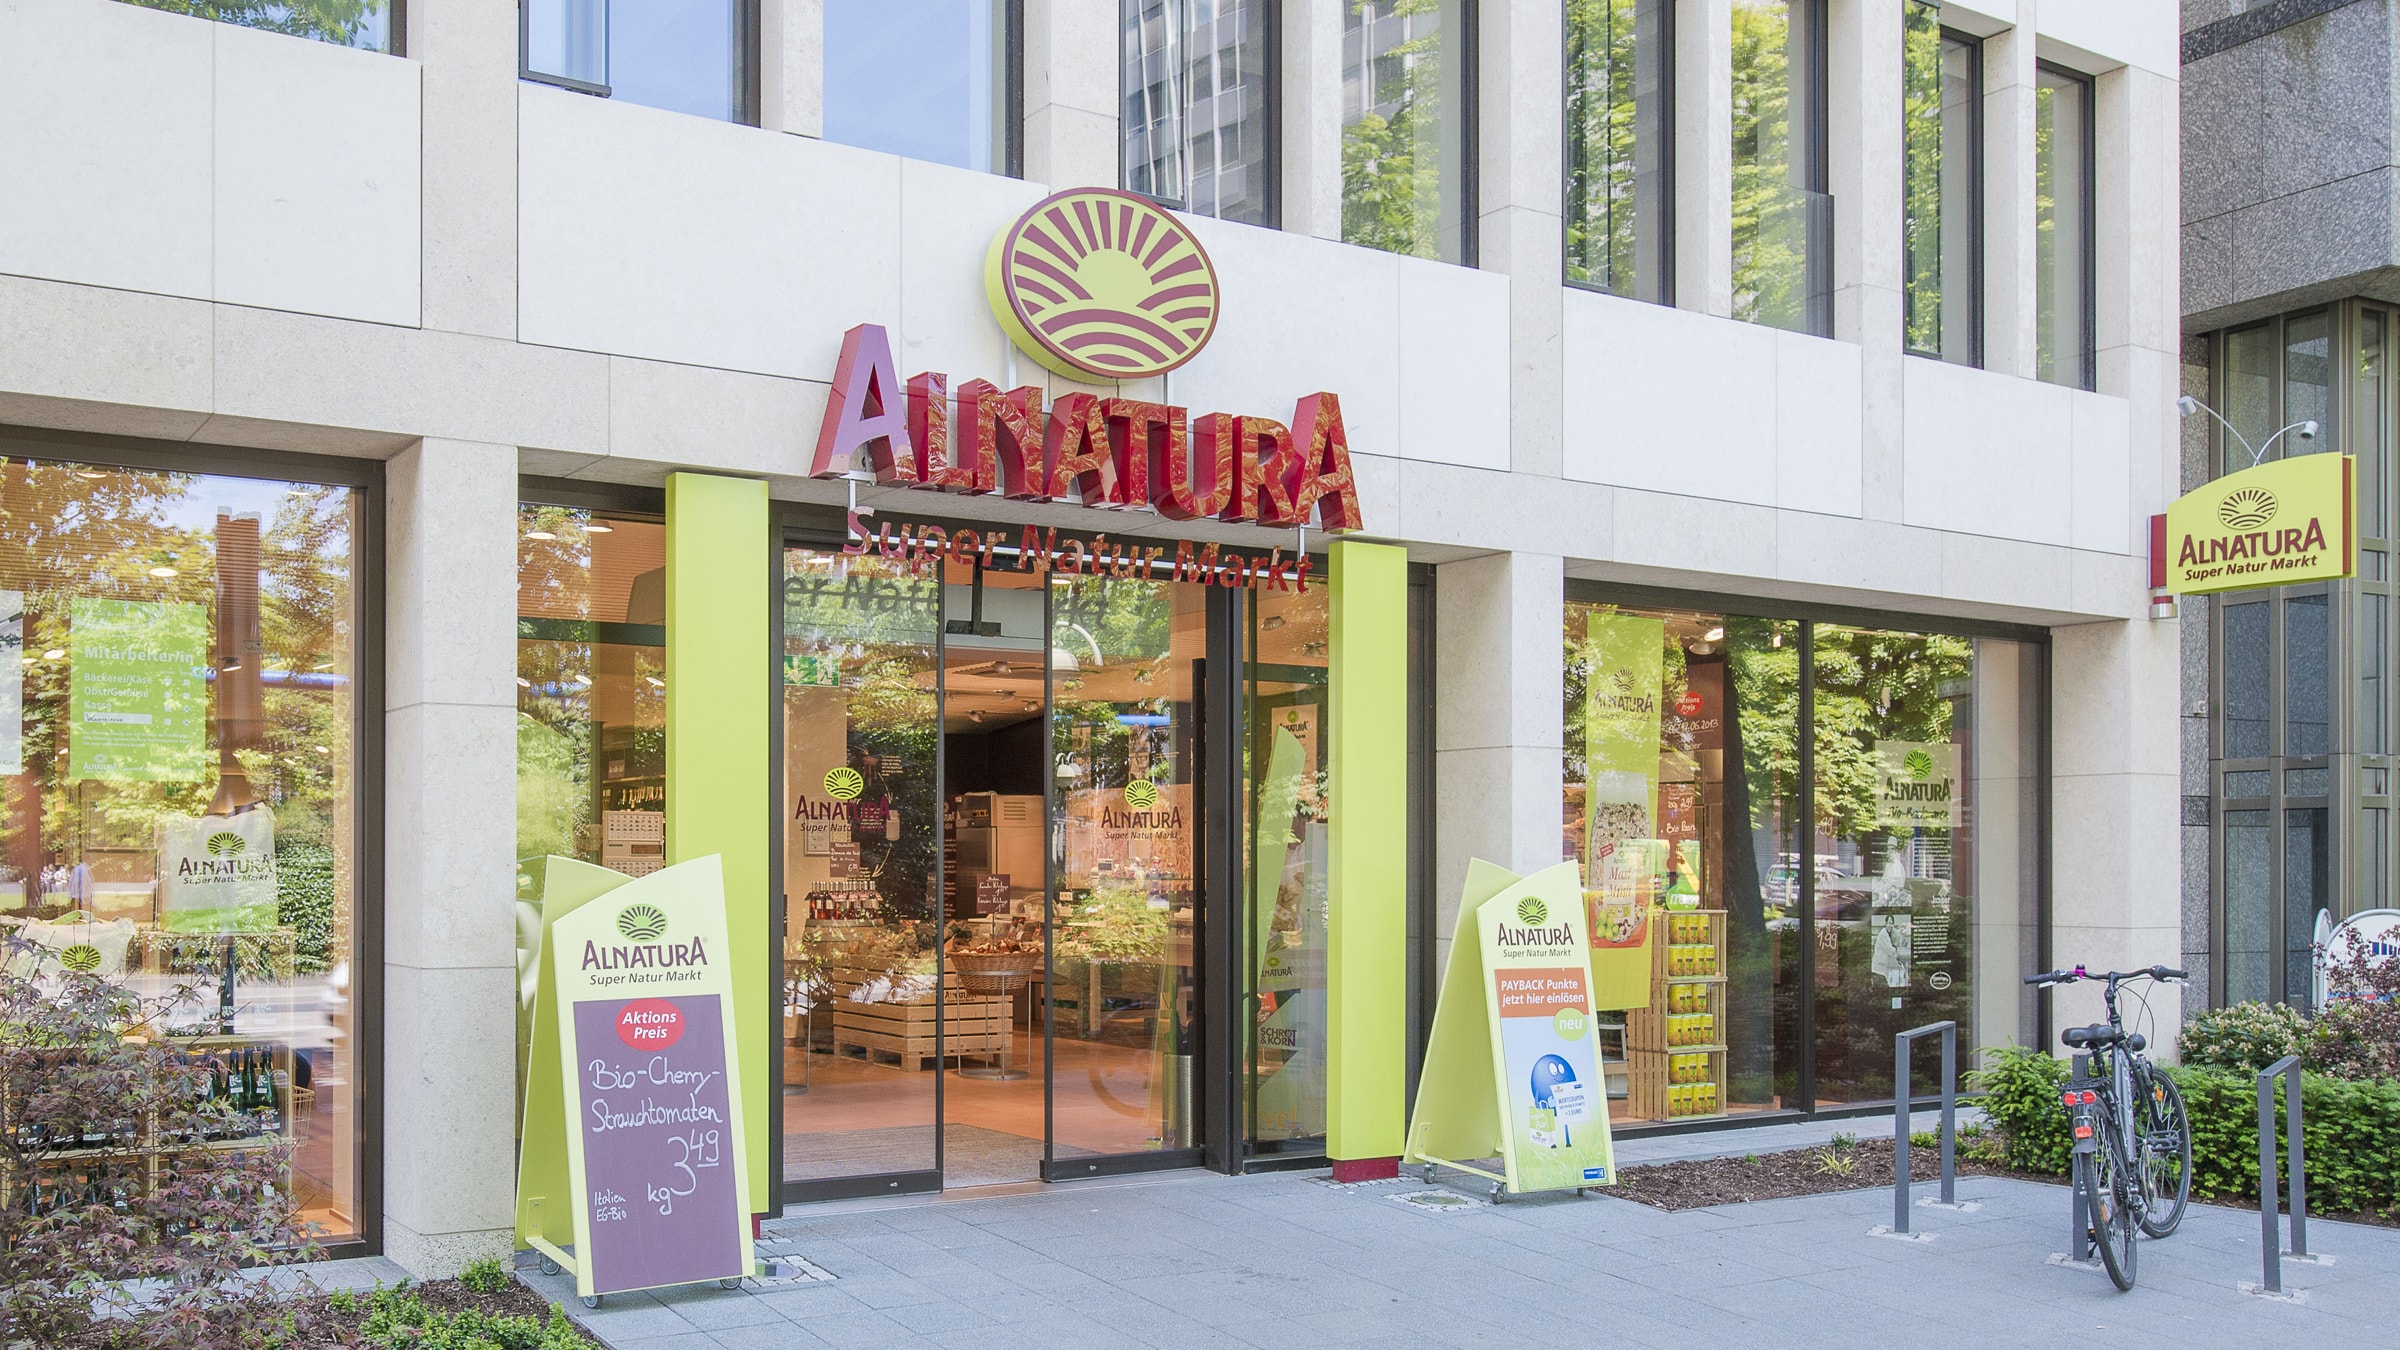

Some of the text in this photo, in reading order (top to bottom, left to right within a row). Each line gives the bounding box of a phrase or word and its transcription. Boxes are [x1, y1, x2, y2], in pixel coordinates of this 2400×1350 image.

[809, 323, 1364, 532] ALNATURA
[843, 505, 1315, 593] Super Natur Markt
[2178, 517, 2327, 567] ALNATURA
[2184, 554, 2318, 582] Super Natur Markt
[83, 645, 195, 664] Mitarbeiter/in
[83, 672, 154, 685] Bäckerei/Käse
[83, 686, 150, 698] Obst/Gemüse
[83, 700, 113, 709] Kasse
[1884, 776, 1951, 801] ALNATURA
[795, 794, 891, 821] ALNATURA
[1101, 805, 1183, 828] ALNATURA
[800, 822, 828, 834] Super
[1105, 831, 1178, 840] Super Natur Markt
[178, 853, 273, 876] ALNATURA
[1498, 922, 1574, 946] ALNATURA
[581, 935, 708, 971] ALNATURA
[1503, 948, 1571, 960] Super Natur Markt
[589, 969, 702, 988] Super Natur Markt
[1501, 979, 1578, 991] PAYBACK Punkte
[1502, 993, 1585, 1007] jetzt hier einlösen
[621, 1010, 677, 1025] Aktions
[1559, 1019, 1583, 1030] neu
[633, 1026, 668, 1040] Preis
[1260, 1027, 1298, 1038] SCHROT
[591, 1092, 724, 1133] Strauchtomaten
[594, 1188, 627, 1207] Italien
[647, 1182, 673, 1216] kg
